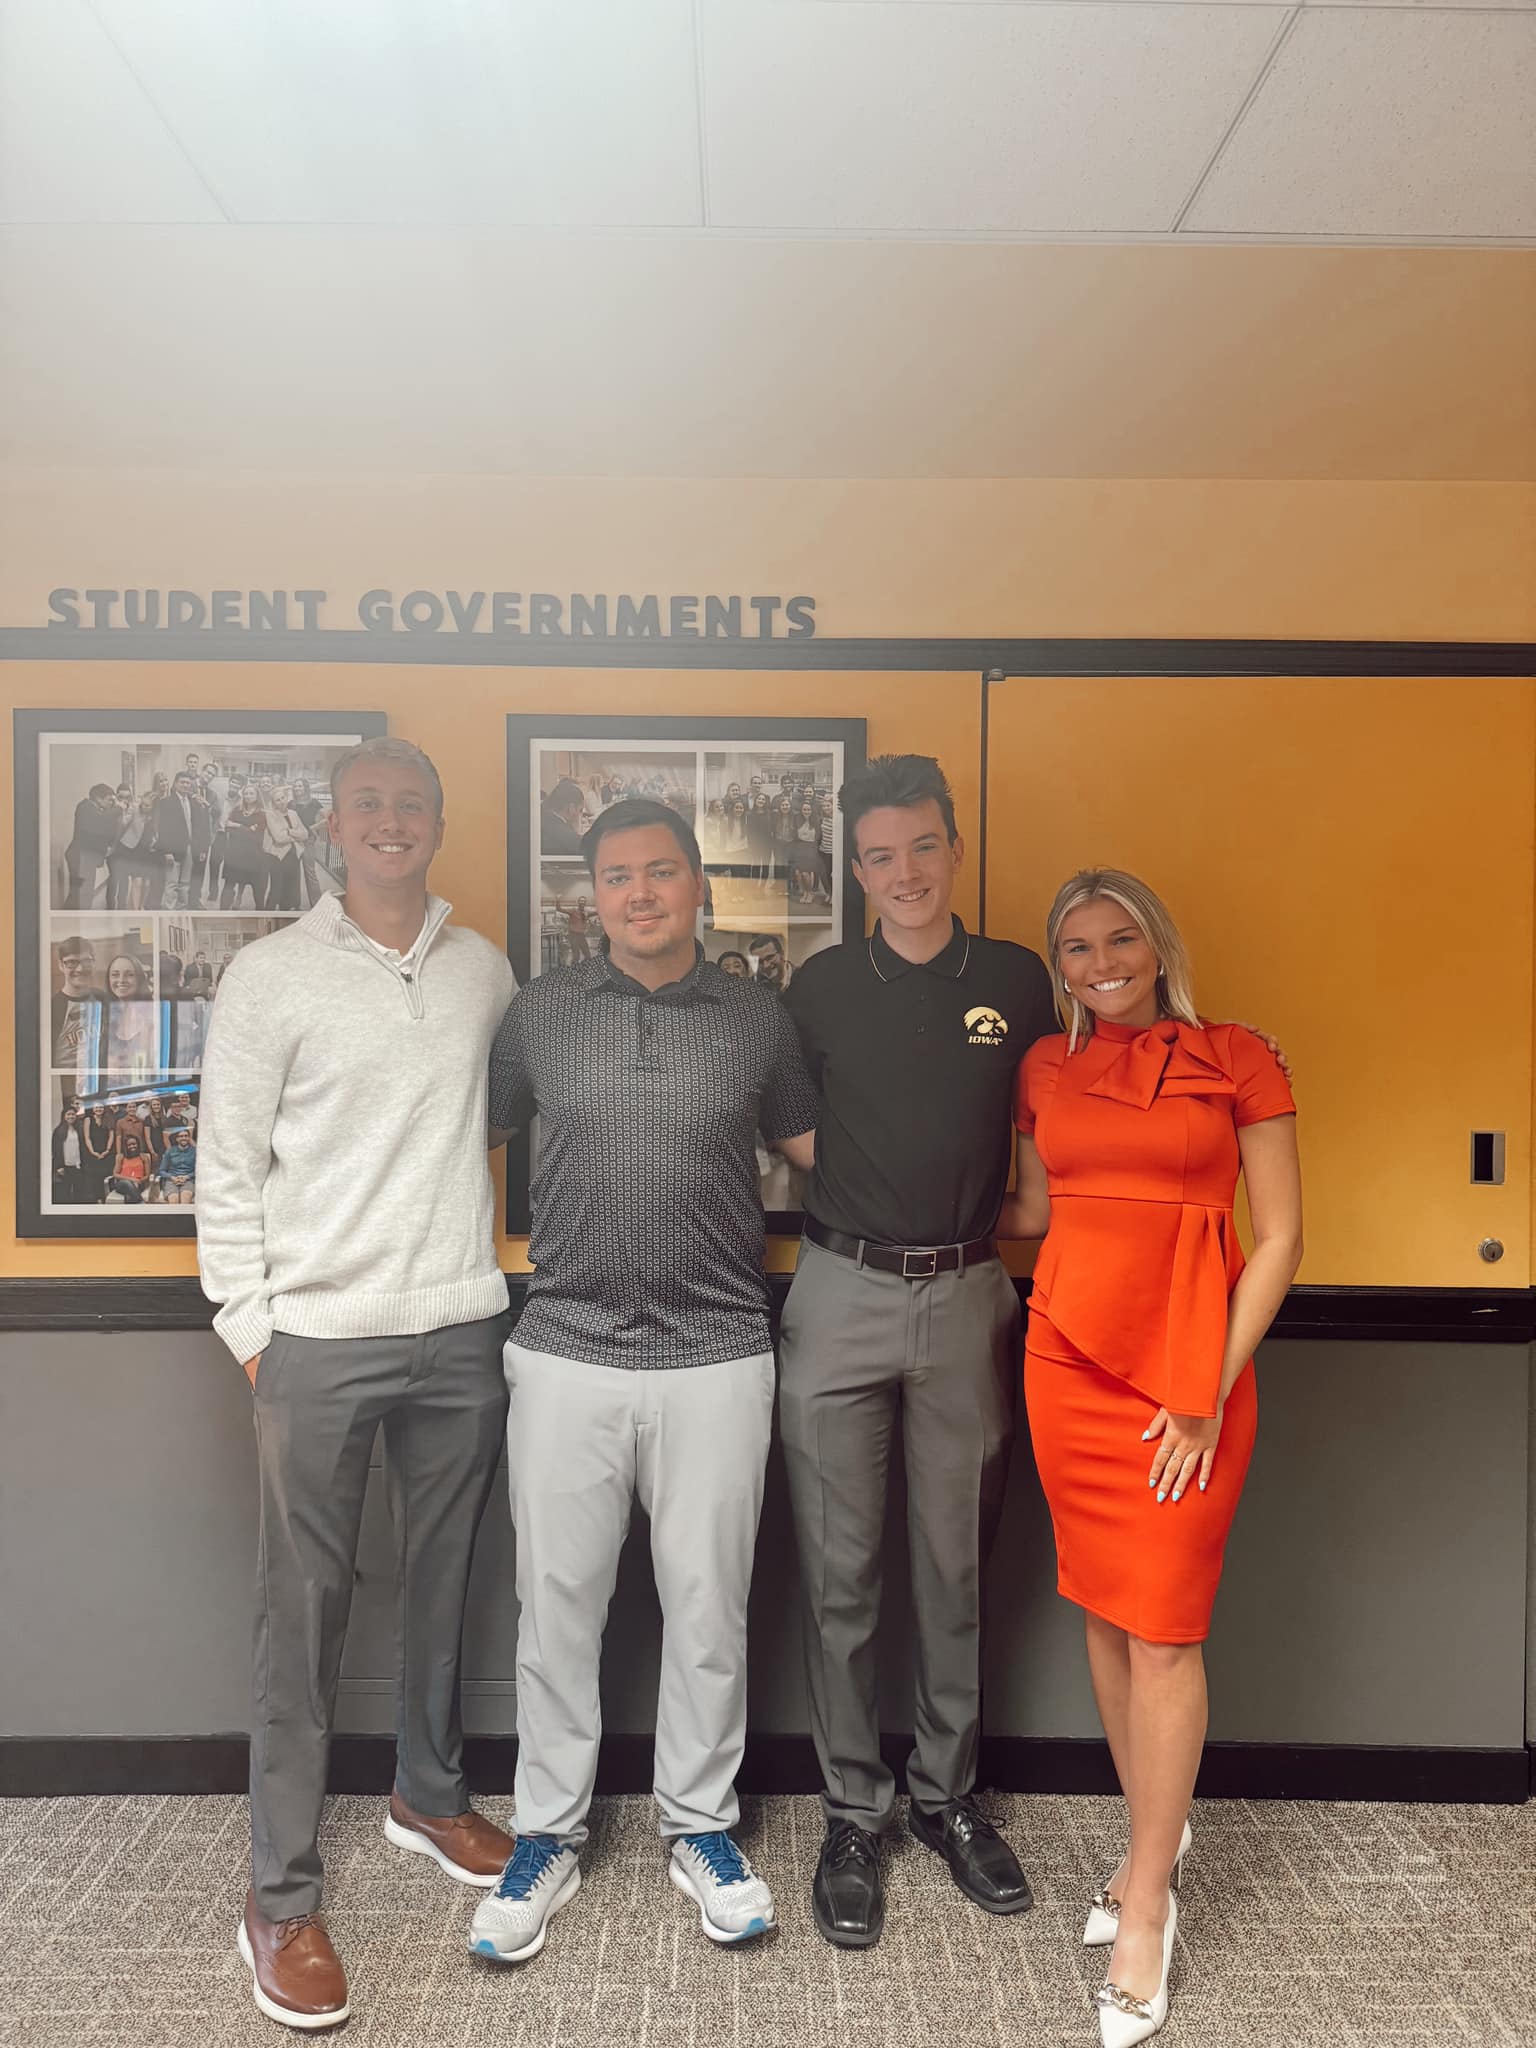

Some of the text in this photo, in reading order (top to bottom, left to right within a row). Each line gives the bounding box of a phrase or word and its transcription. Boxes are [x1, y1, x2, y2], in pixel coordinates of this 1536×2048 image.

[48, 588, 817, 640] STUDENT GOVERNMENTS
[968, 1035, 999, 1046] IOWA
